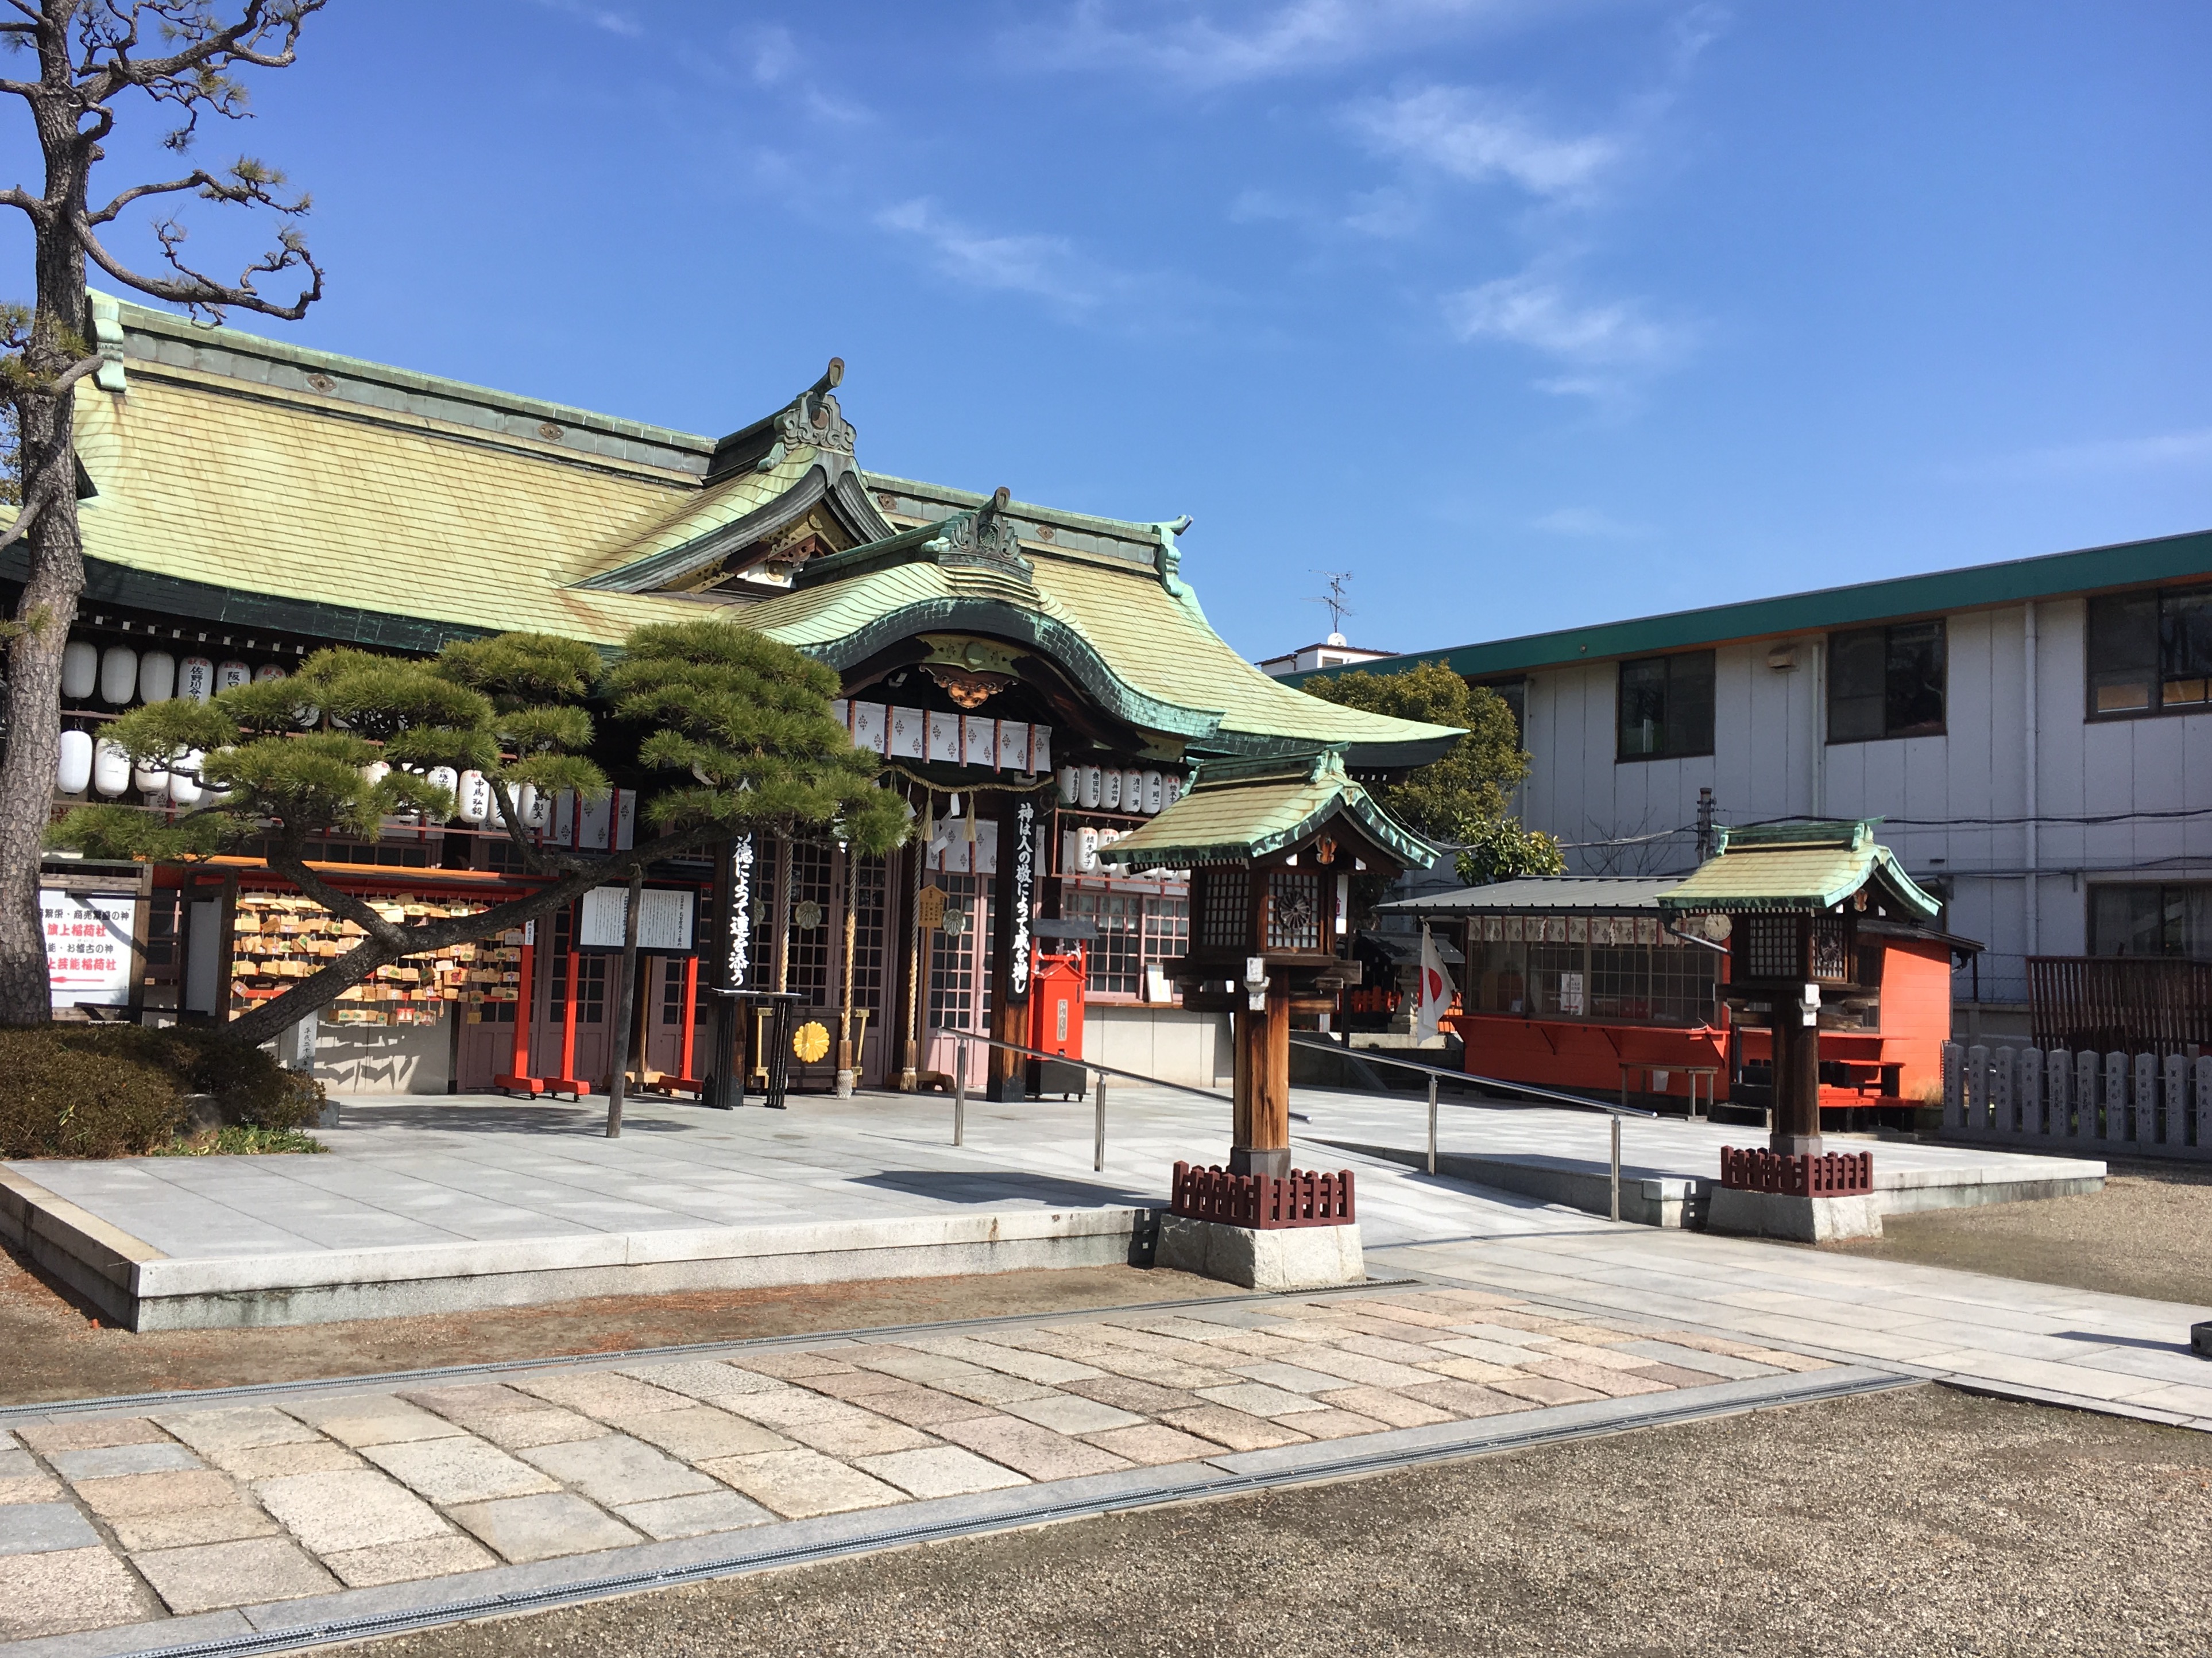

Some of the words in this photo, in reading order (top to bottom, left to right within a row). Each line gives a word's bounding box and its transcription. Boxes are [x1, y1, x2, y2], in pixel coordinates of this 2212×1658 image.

[47, 943, 114, 954] 能・お稽古の神
[1012, 802, 1034, 994] 神は人の敬によって威を増し
